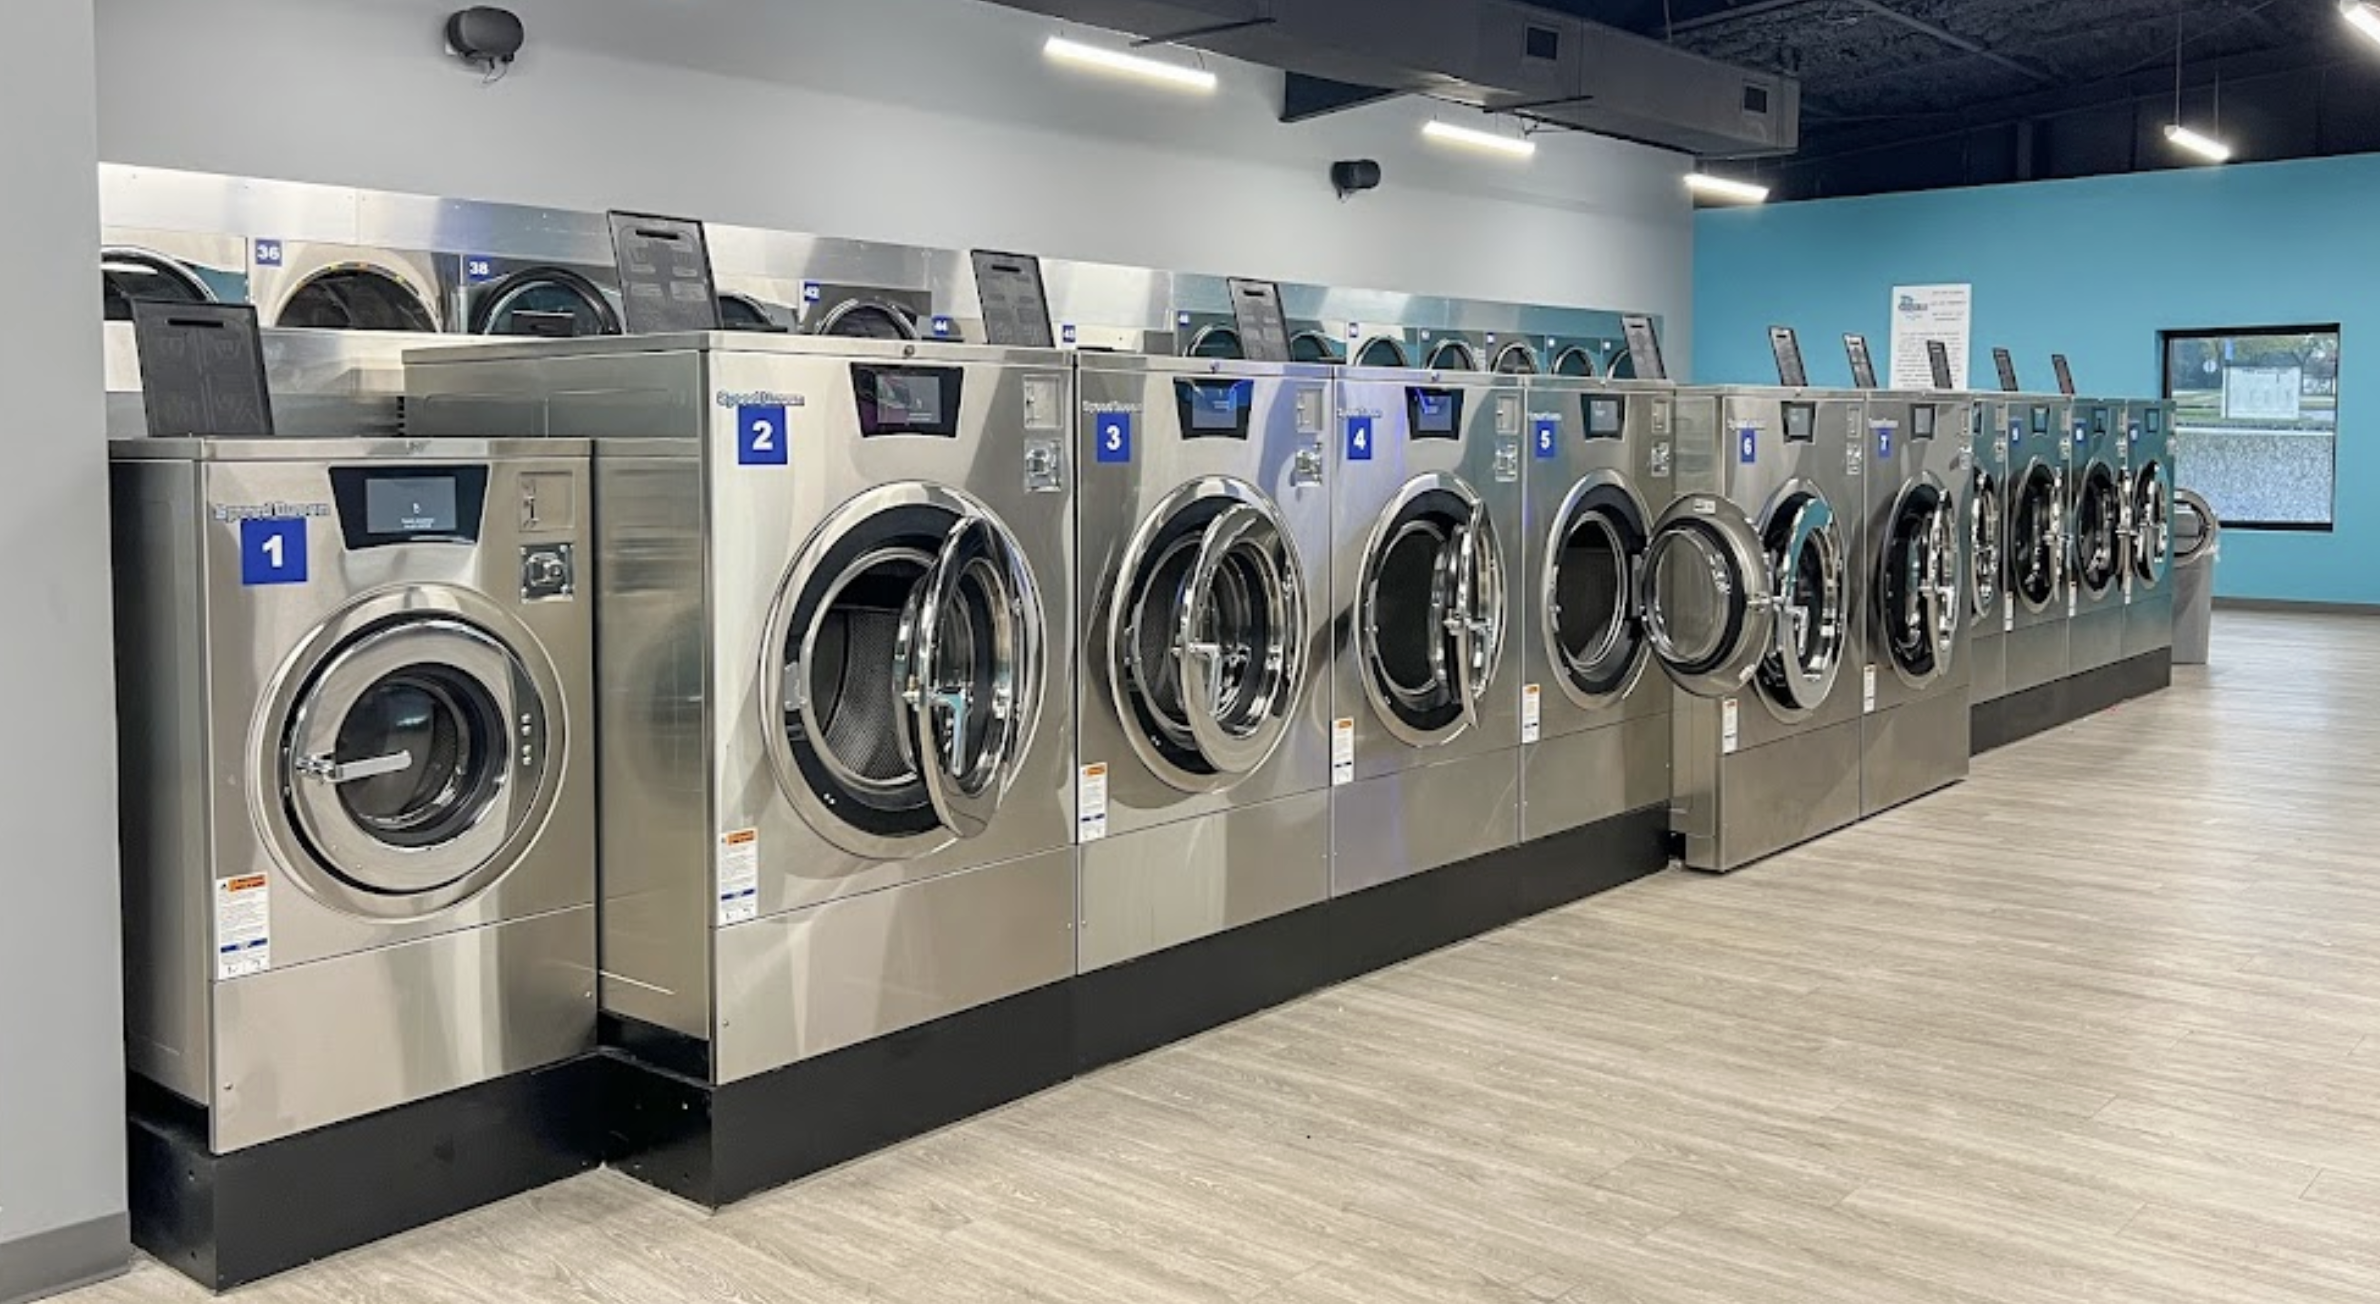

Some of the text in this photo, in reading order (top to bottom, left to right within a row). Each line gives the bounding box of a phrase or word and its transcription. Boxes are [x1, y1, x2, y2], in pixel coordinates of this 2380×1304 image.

[257, 244, 280, 260] 36
[469, 261, 489, 275] 38
[752, 420, 773, 450] 2
[1106, 425, 1121, 450] 3
[1353, 427, 1366, 450] 4
[1541, 430, 1551, 450] 5
[1880, 435, 1888, 451] 7
[1743, 437, 1752, 455] 6
[262, 534, 283, 568] 1
